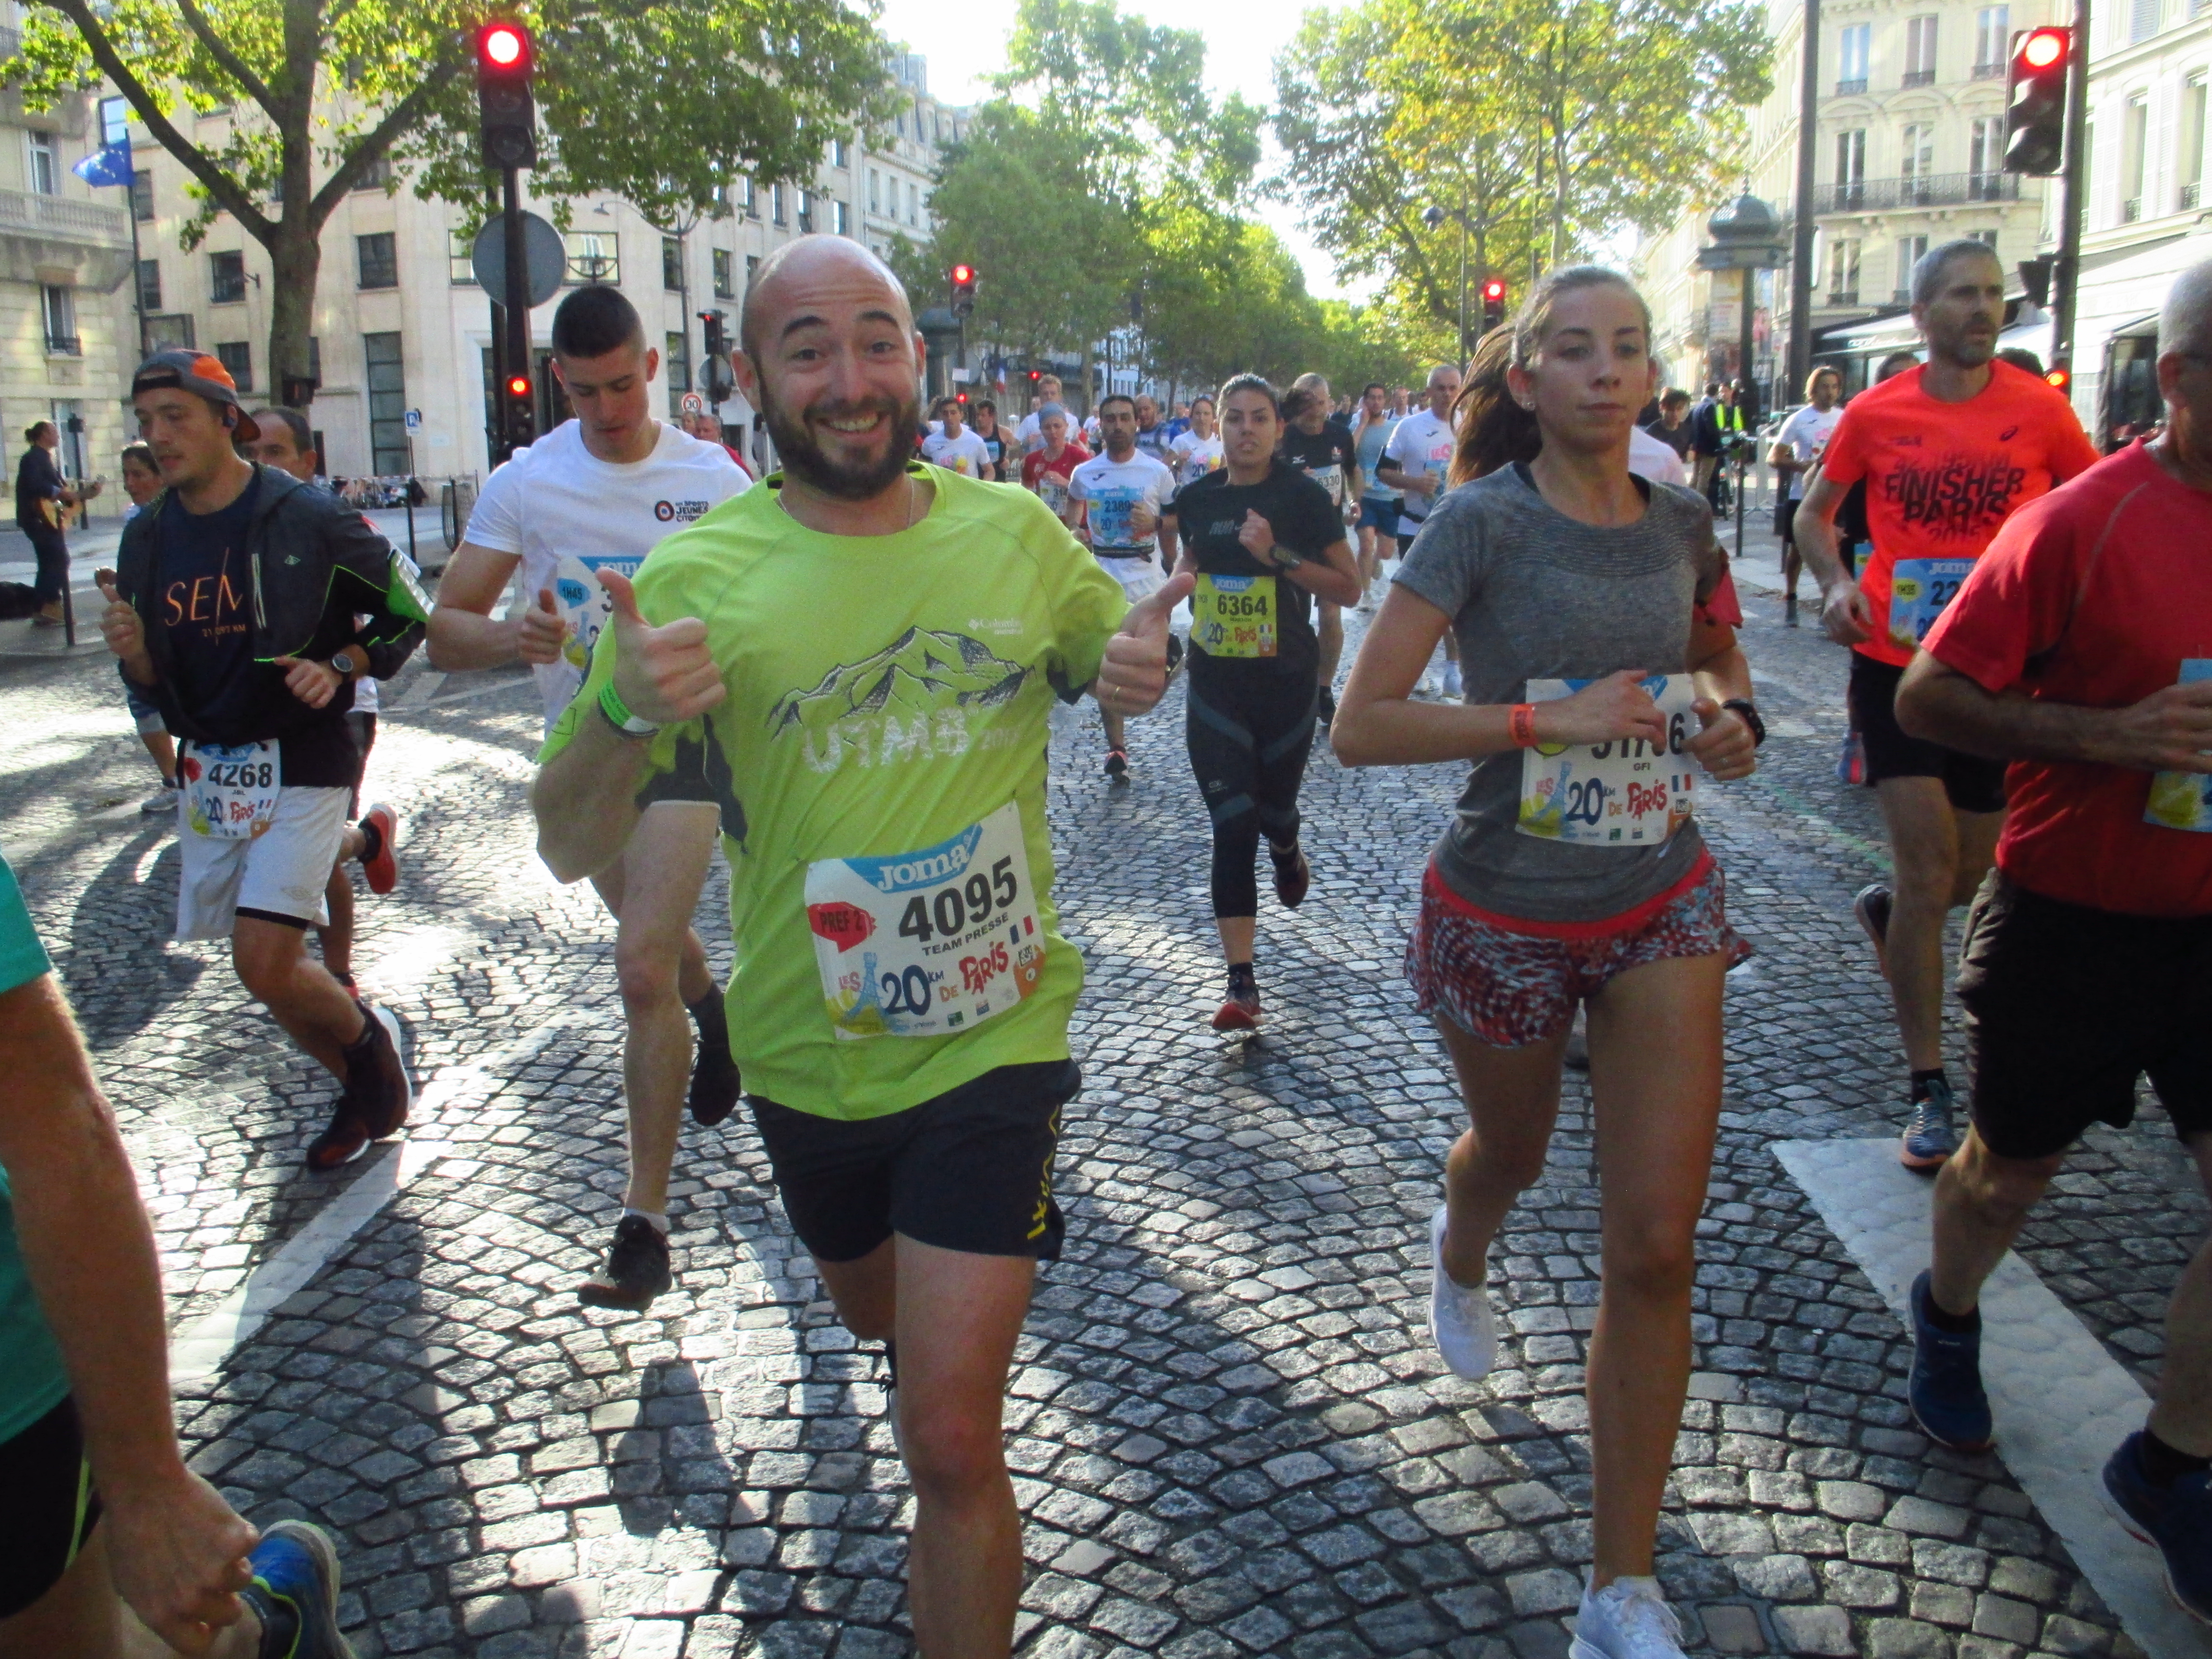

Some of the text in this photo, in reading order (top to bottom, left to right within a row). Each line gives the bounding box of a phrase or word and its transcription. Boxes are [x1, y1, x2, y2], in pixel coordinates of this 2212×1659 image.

[687, 400, 698, 409] 30
[1886, 467, 2025, 502] FINISHER
[676, 506, 709, 515] JEUNES
[1217, 594, 1268, 616] 6364
[1207, 622, 1224, 645] 20
[803, 707, 969, 774] UTMB
[208, 762, 273, 789] 4268
[1633, 762, 1650, 771] GFI
[1566, 777, 1604, 826] 20
[899, 855, 1017, 942] 4095
[819, 909, 864, 934] PREF 2
[922, 912, 1010, 957] TEAM PRESSE
[881, 964, 932, 1016] 20
[927, 970, 945, 985] KM
[938, 984, 959, 1002] DE
